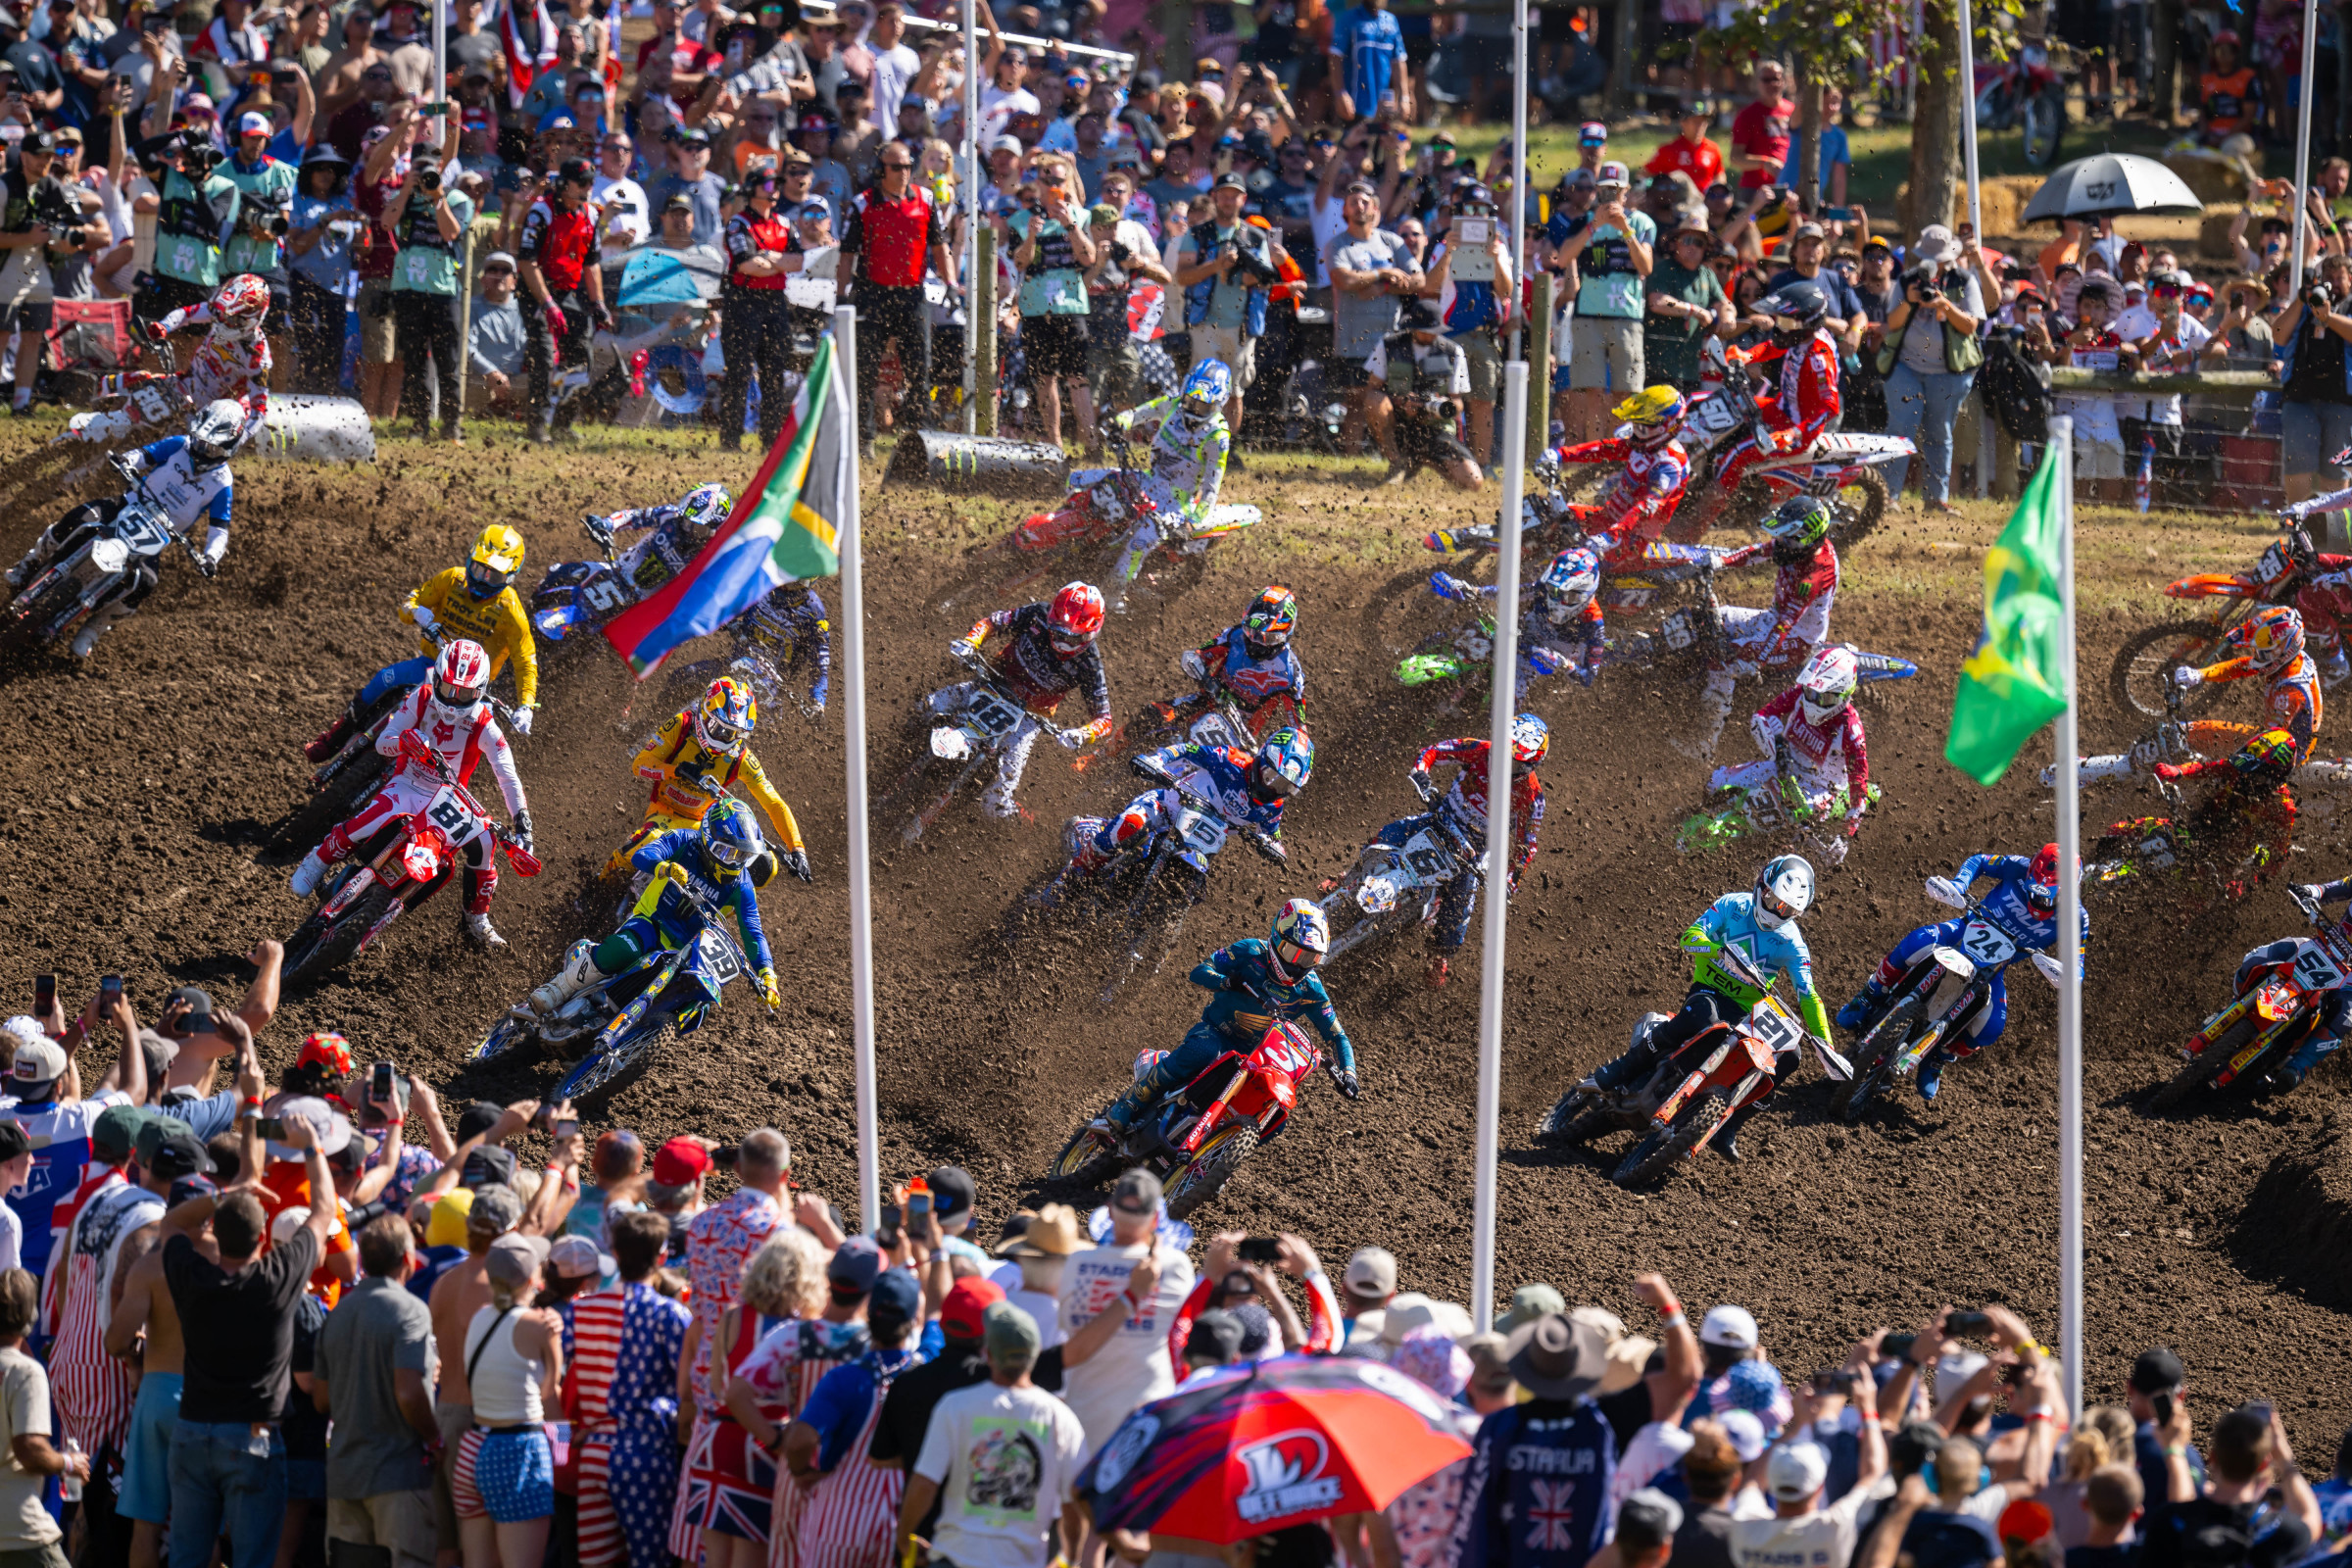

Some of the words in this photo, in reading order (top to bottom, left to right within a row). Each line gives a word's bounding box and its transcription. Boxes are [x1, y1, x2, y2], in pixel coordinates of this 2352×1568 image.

[172, 255, 196, 272] TV
[406, 269, 429, 283] TV
[1699, 397, 1736, 430] 50
[119, 512, 162, 547] 57
[2255, 548, 2284, 583] 35
[446, 595, 475, 617] TROY
[582, 579, 627, 612] 5
[968, 691, 1017, 734] 18
[1791, 718, 1827, 755] LATVIA
[410, 758, 440, 777] HON
[428, 801, 474, 841] 81
[1184, 816, 1221, 847] 15
[1404, 847, 1447, 879] 6
[686, 868, 720, 902] YAMAHA
[2031, 883, 2050, 896] Arai
[2002, 888, 2053, 939] ITALIA
[1966, 929, 2005, 961] 24
[2001, 919, 2036, 946] SHOT
[700, 938, 735, 980] 39
[2297, 950, 2337, 989] 54
[1705, 963, 1742, 996] TEM
[1286, 1022, 1313, 1051] RENTHAL
[1752, 1009, 1793, 1052] 21
[1263, 1040, 1308, 1073] 3
[1188, 1110, 1213, 1144] DUNLOP
